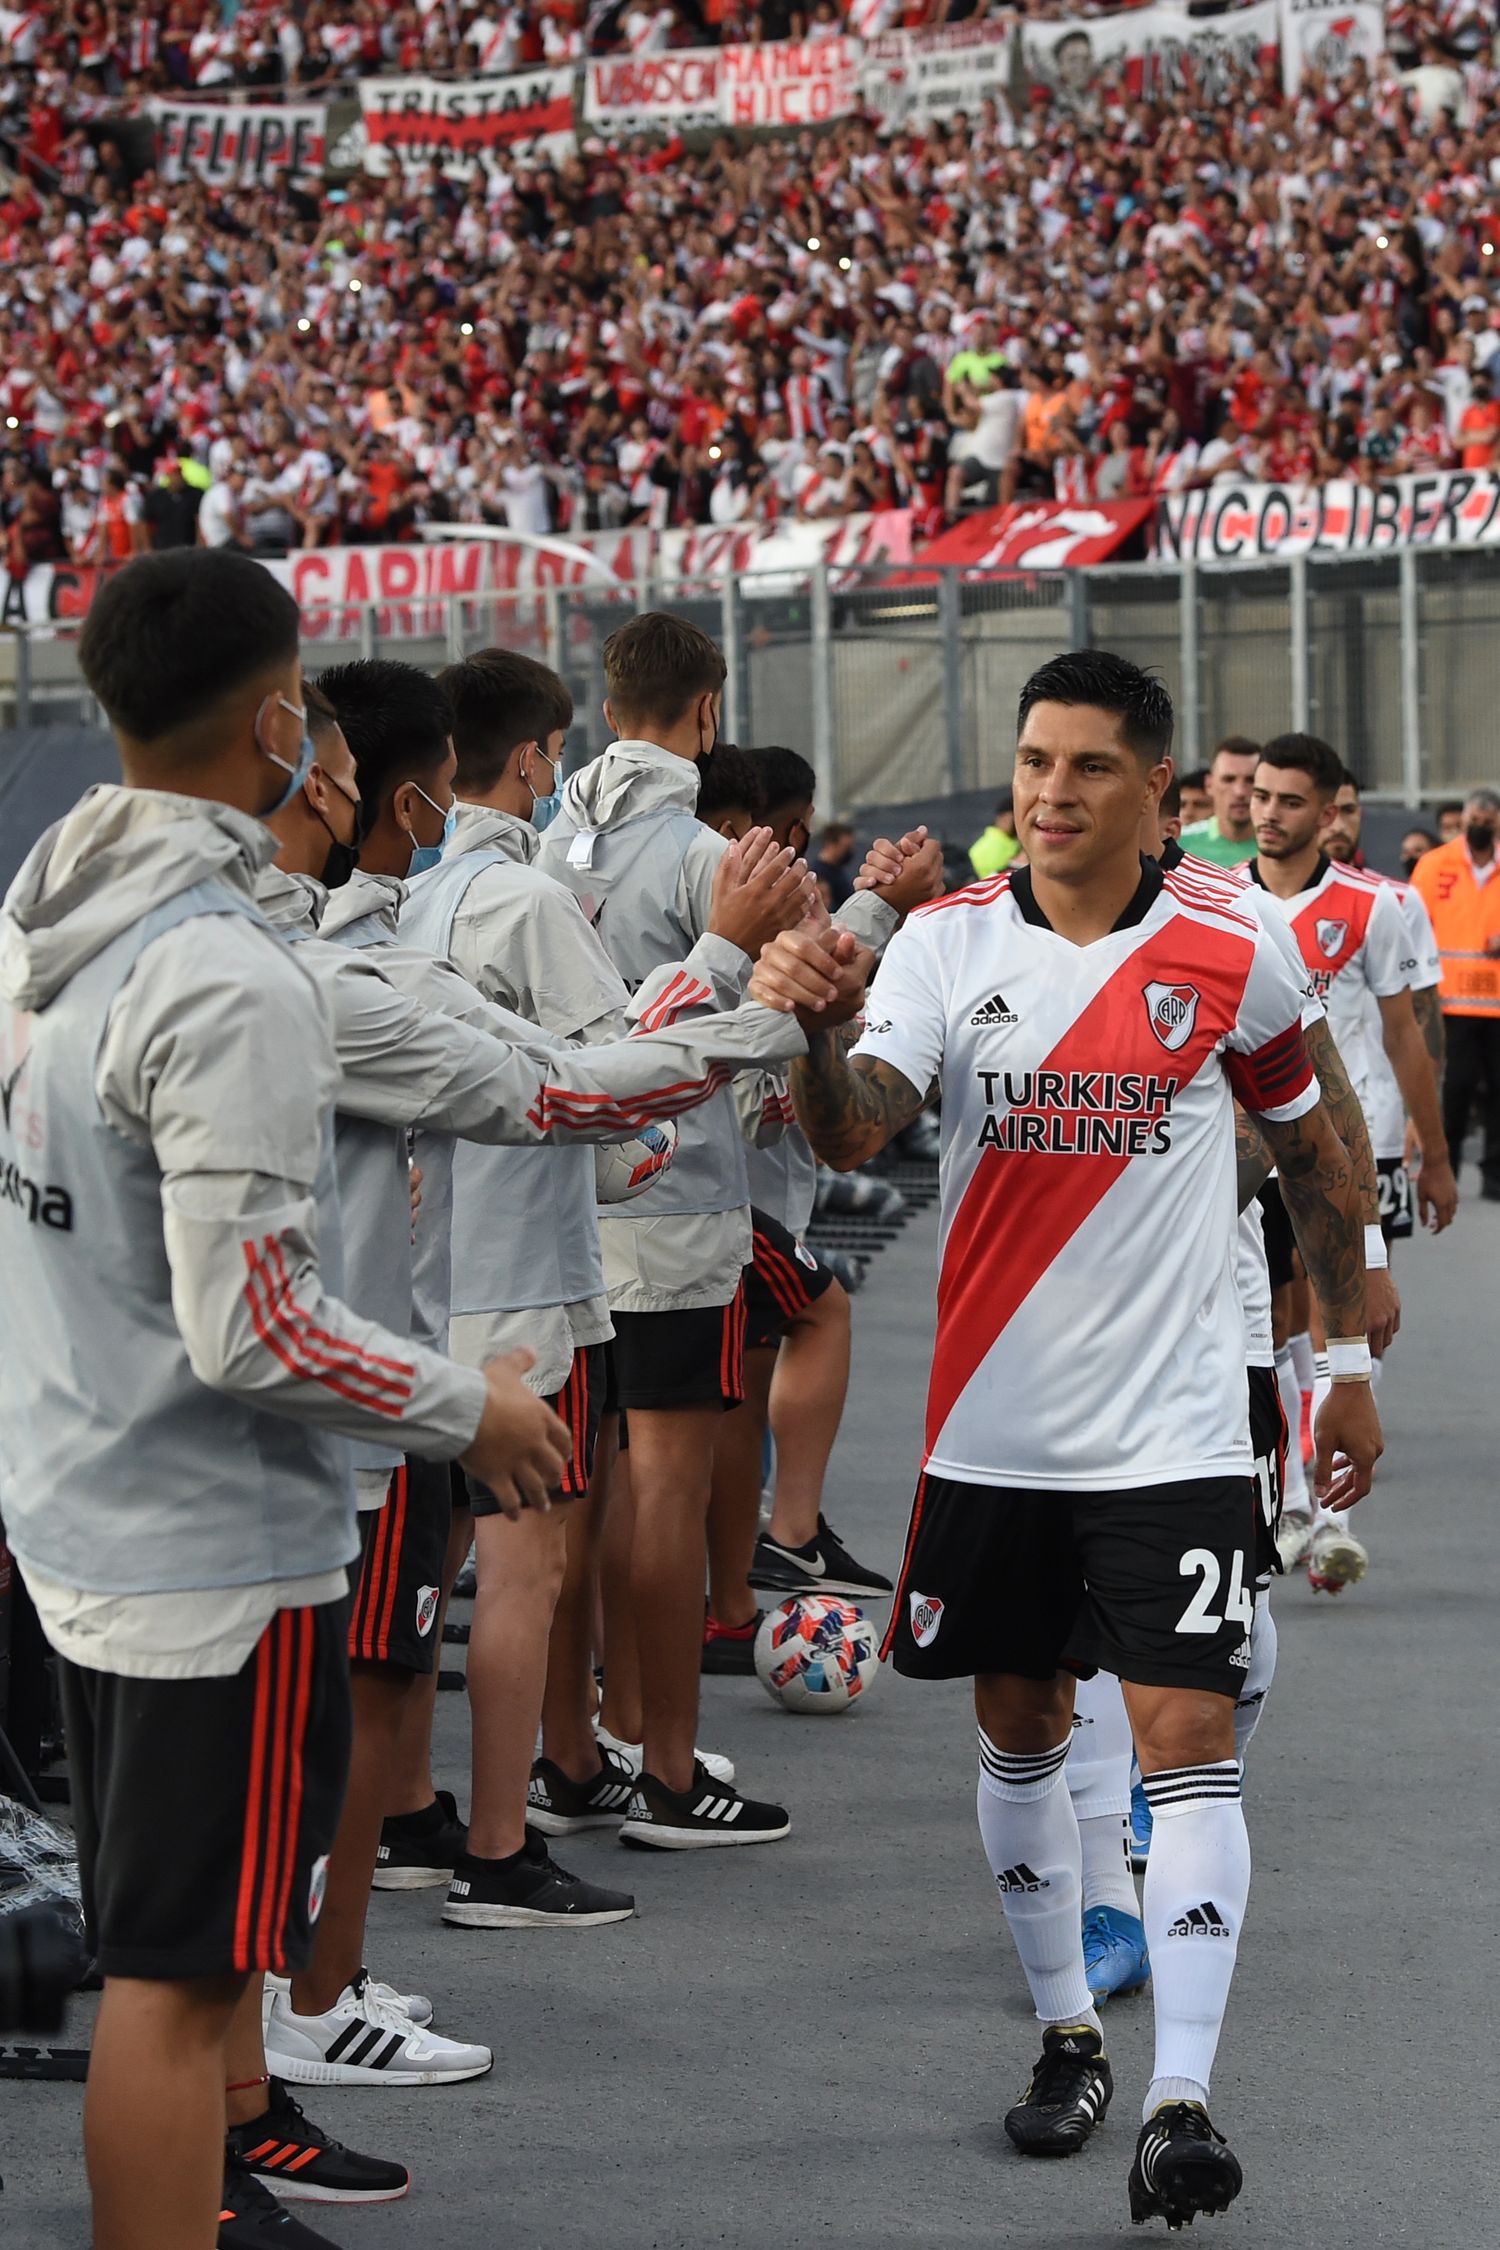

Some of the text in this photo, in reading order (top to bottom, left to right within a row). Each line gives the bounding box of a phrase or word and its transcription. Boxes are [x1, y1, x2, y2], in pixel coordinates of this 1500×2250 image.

[376, 79, 554, 124] TRISTAN
[160, 112, 316, 176] FELIPE
[970, 1013, 1019, 1026] adidas
[976, 1070, 1179, 1114] TURKISH
[976, 1113, 1173, 1156] AIRLINES
[1378, 1168, 1409, 1216] 29
[1175, 1548, 1253, 1634] 24
[1167, 1921, 1230, 1937] adidas
